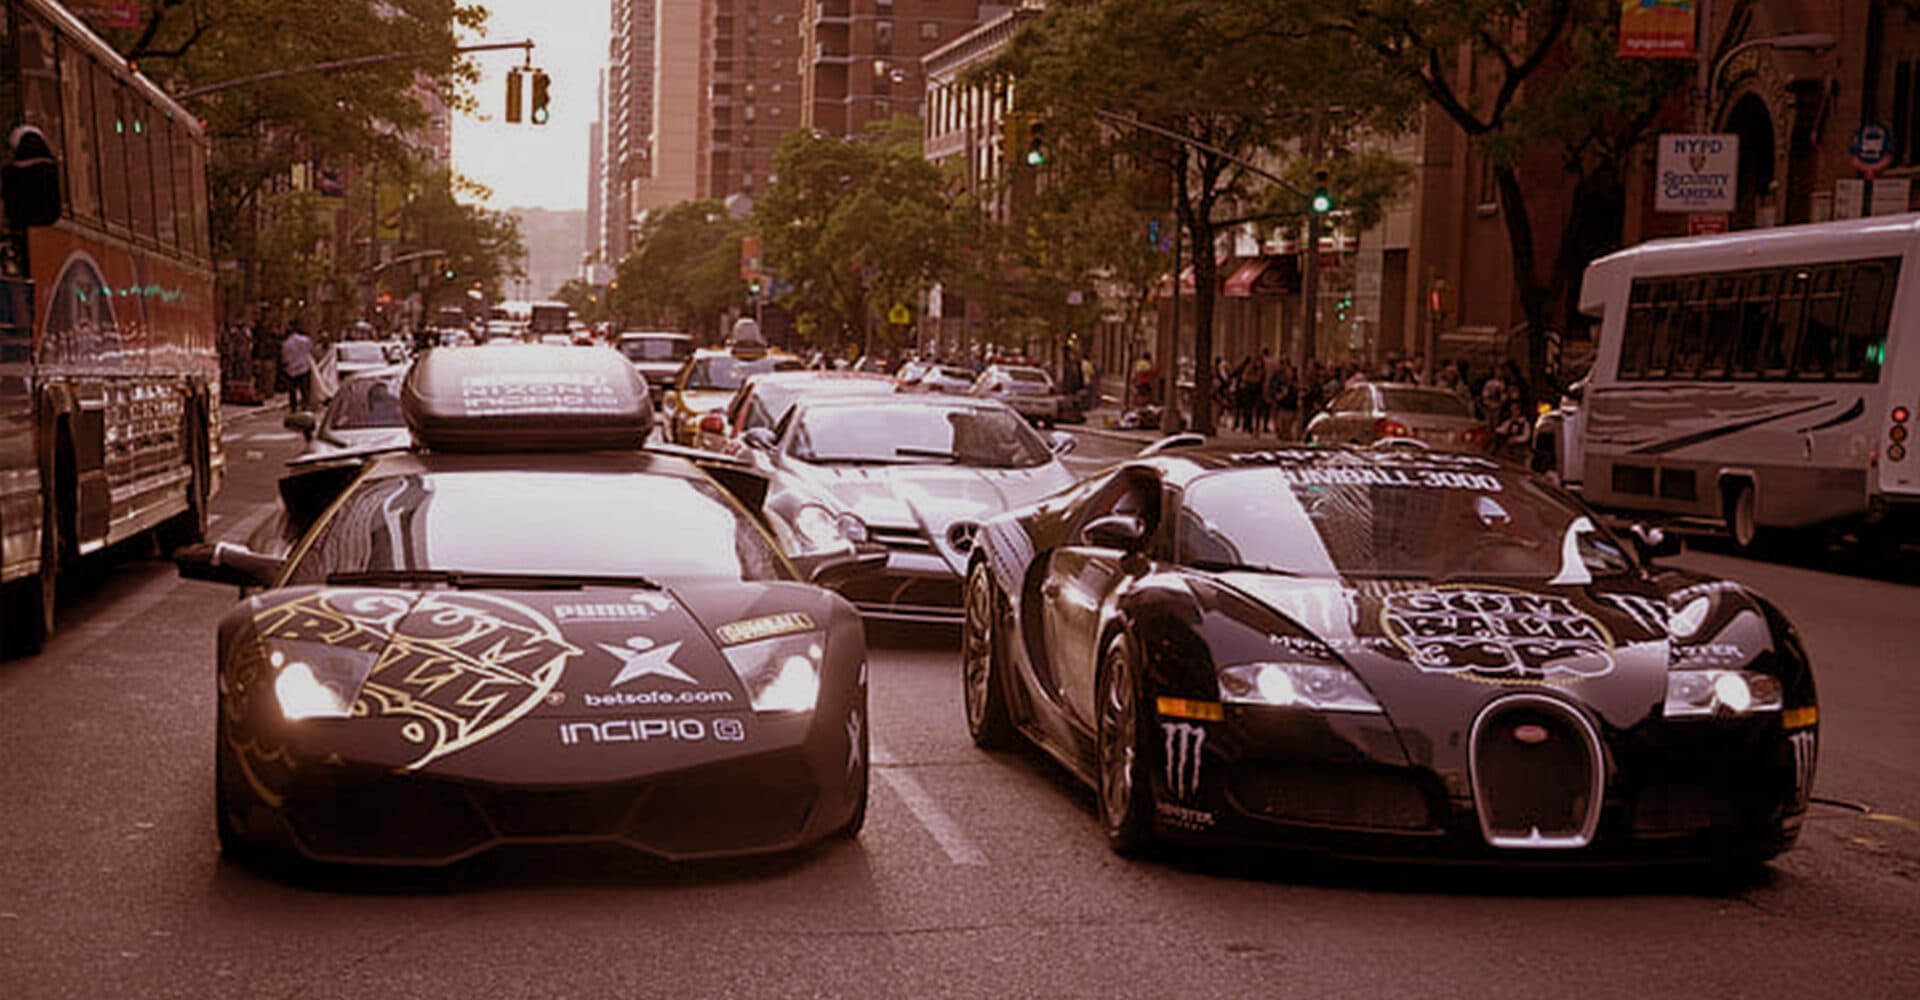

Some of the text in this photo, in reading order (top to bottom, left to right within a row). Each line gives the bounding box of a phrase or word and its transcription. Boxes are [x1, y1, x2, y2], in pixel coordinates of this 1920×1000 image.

[1674, 140, 1722, 153] NYPD
[1663, 171, 1728, 186] SECURITY
[1664, 184, 1726, 199] CAMERA
[1280, 467, 1502, 491] UMBALL 3000
[553, 603, 648, 620] PUMA
[584, 690, 733, 706] betsafe.com
[560, 719, 706, 744] INCIPIO
